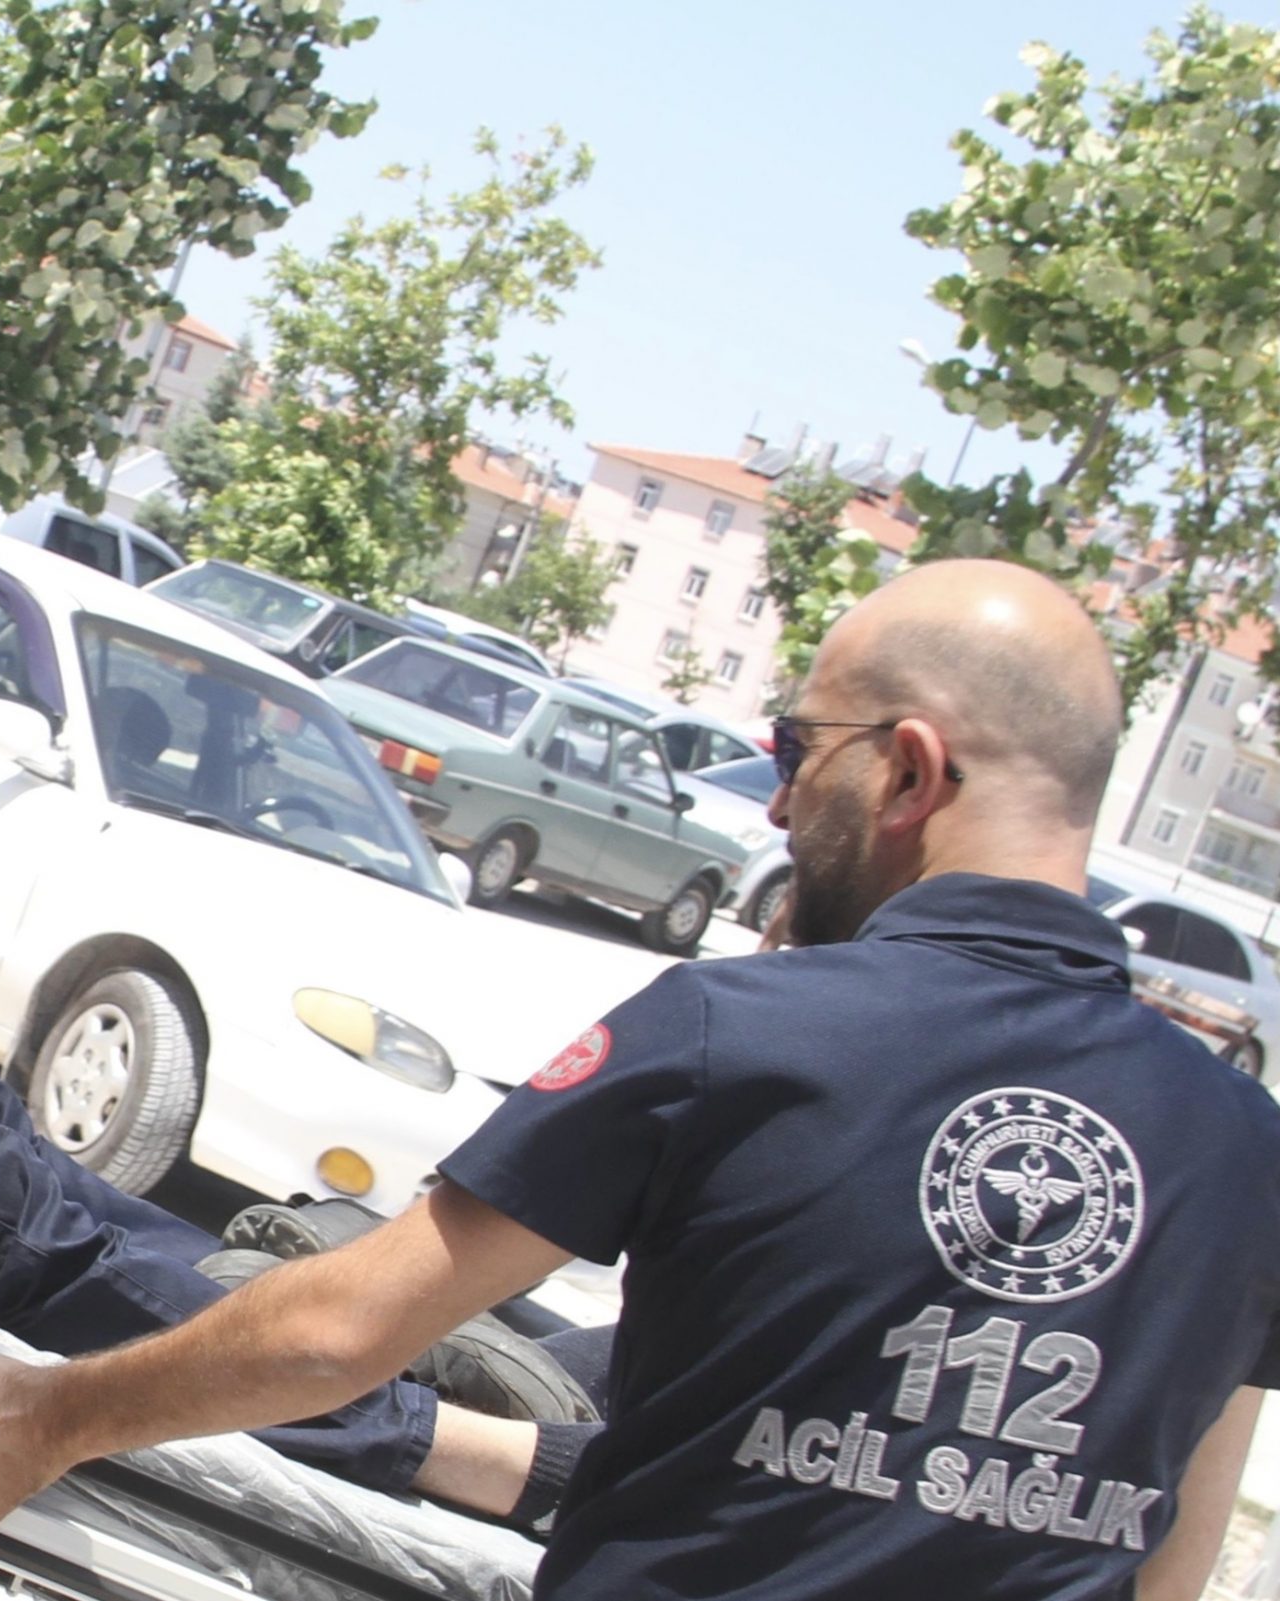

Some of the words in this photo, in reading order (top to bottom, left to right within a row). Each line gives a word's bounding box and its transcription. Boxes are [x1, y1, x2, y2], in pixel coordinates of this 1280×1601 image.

[880, 1304, 1102, 1455] 112
[732, 1407, 901, 1501] ACİL
[916, 1445, 1163, 1551] SAĞLIK
